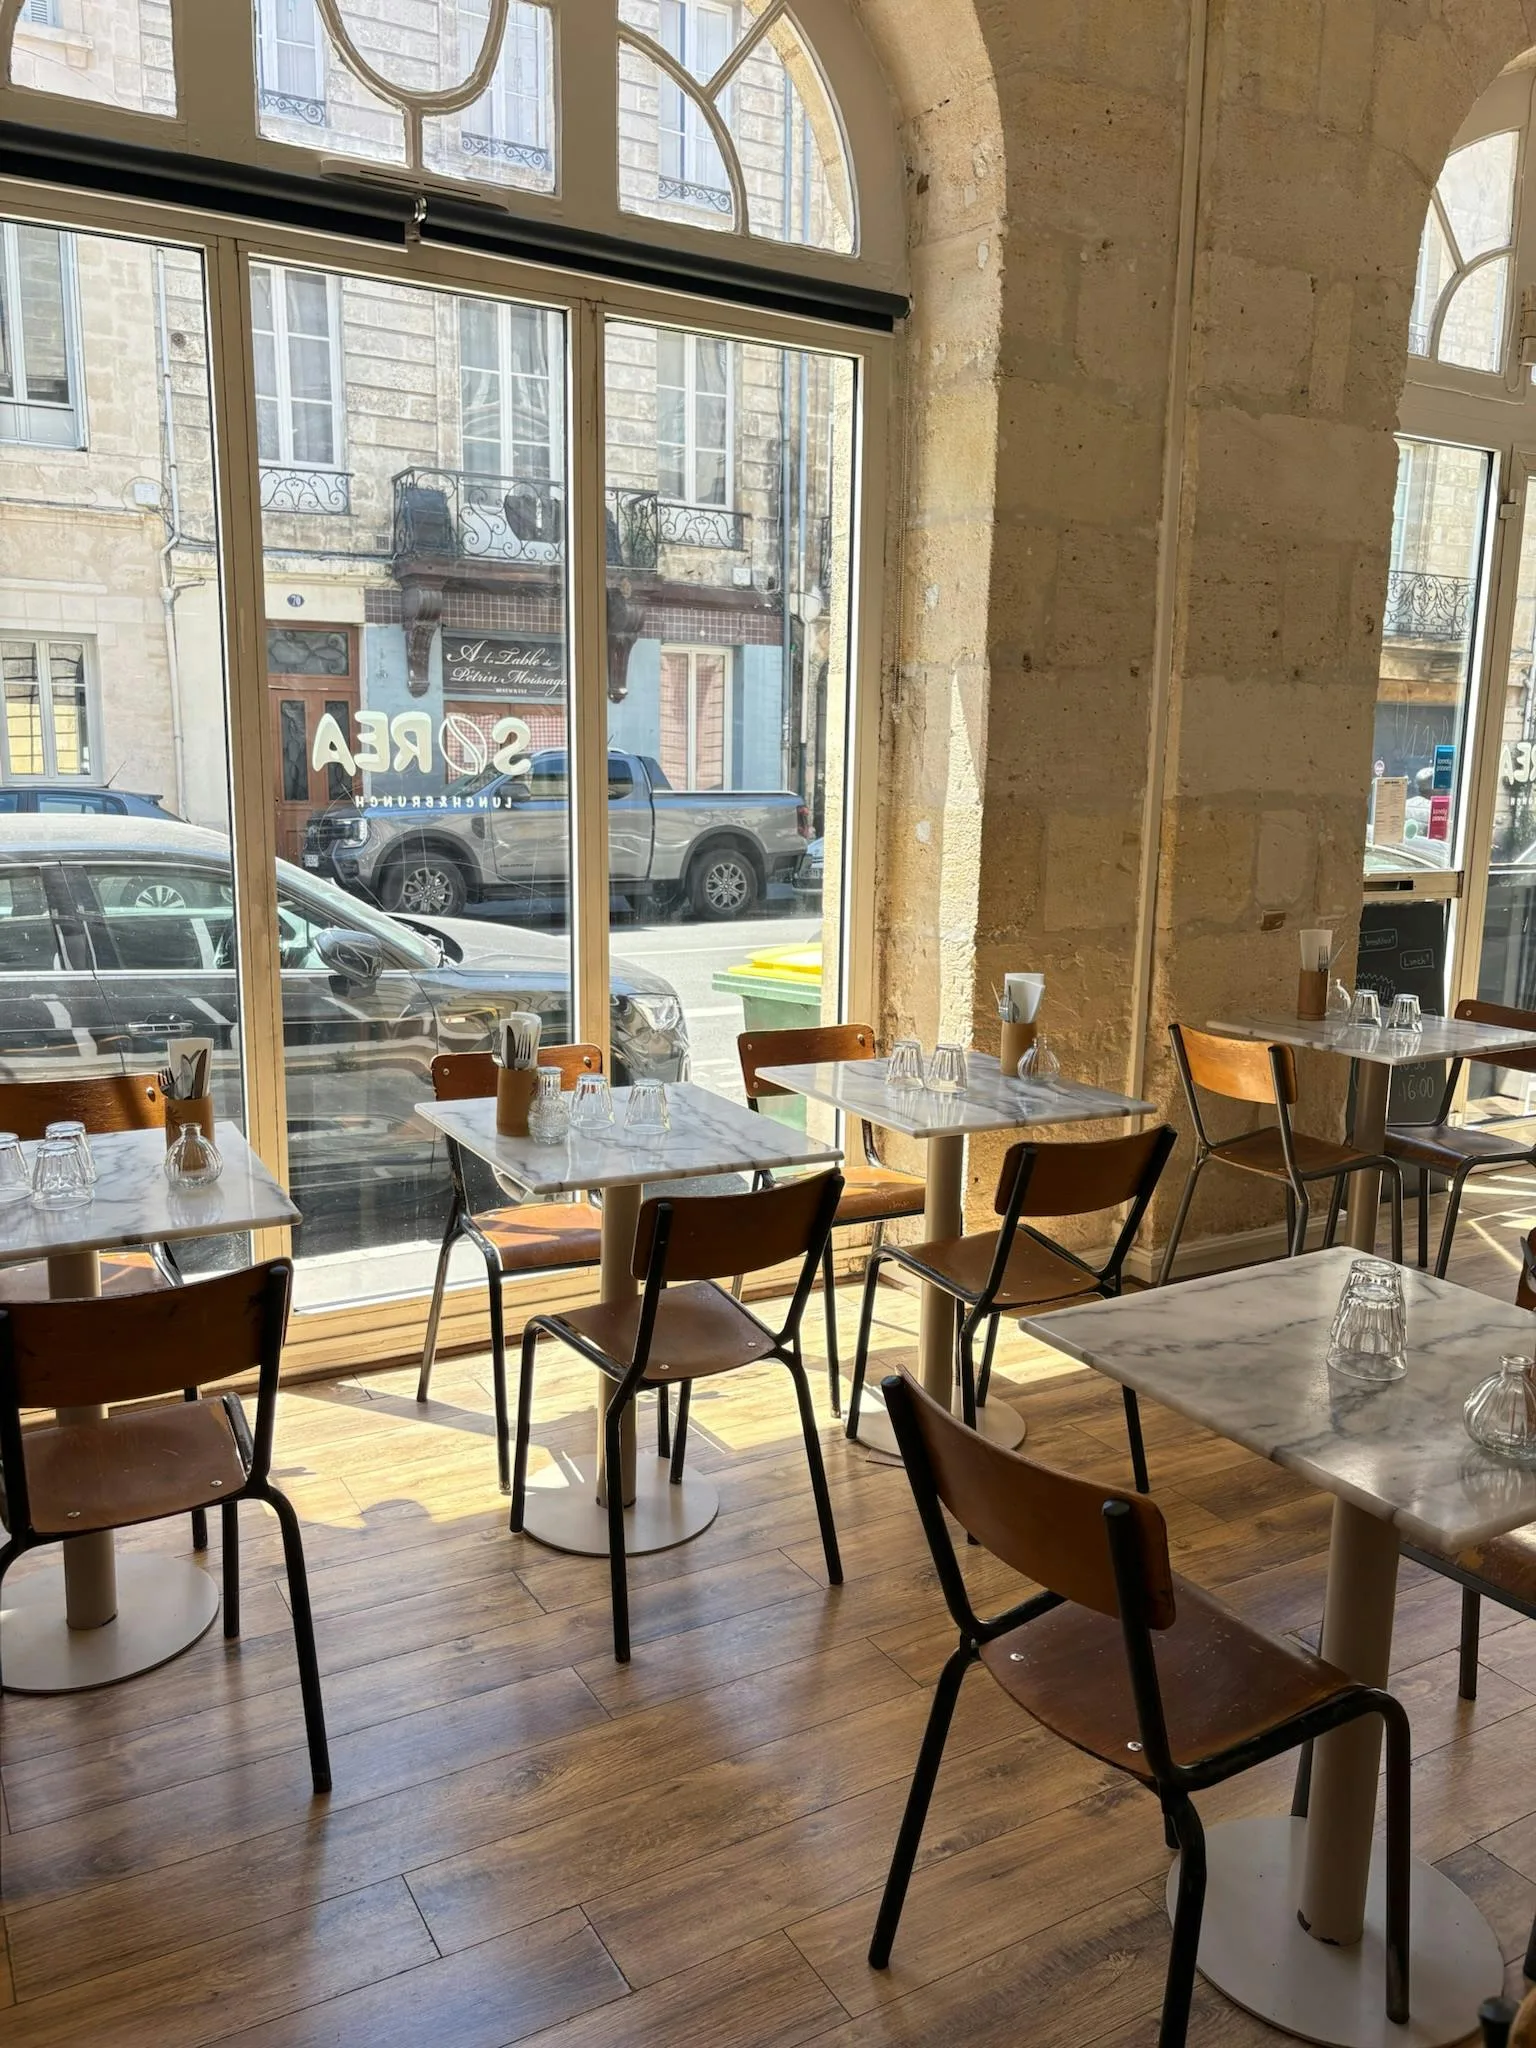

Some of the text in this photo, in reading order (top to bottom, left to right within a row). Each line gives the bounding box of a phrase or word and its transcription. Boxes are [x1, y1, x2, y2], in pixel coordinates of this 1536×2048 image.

[290, 594, 302, 607] 70
[446, 639, 488, 663] A
[494, 647, 546, 666] Table
